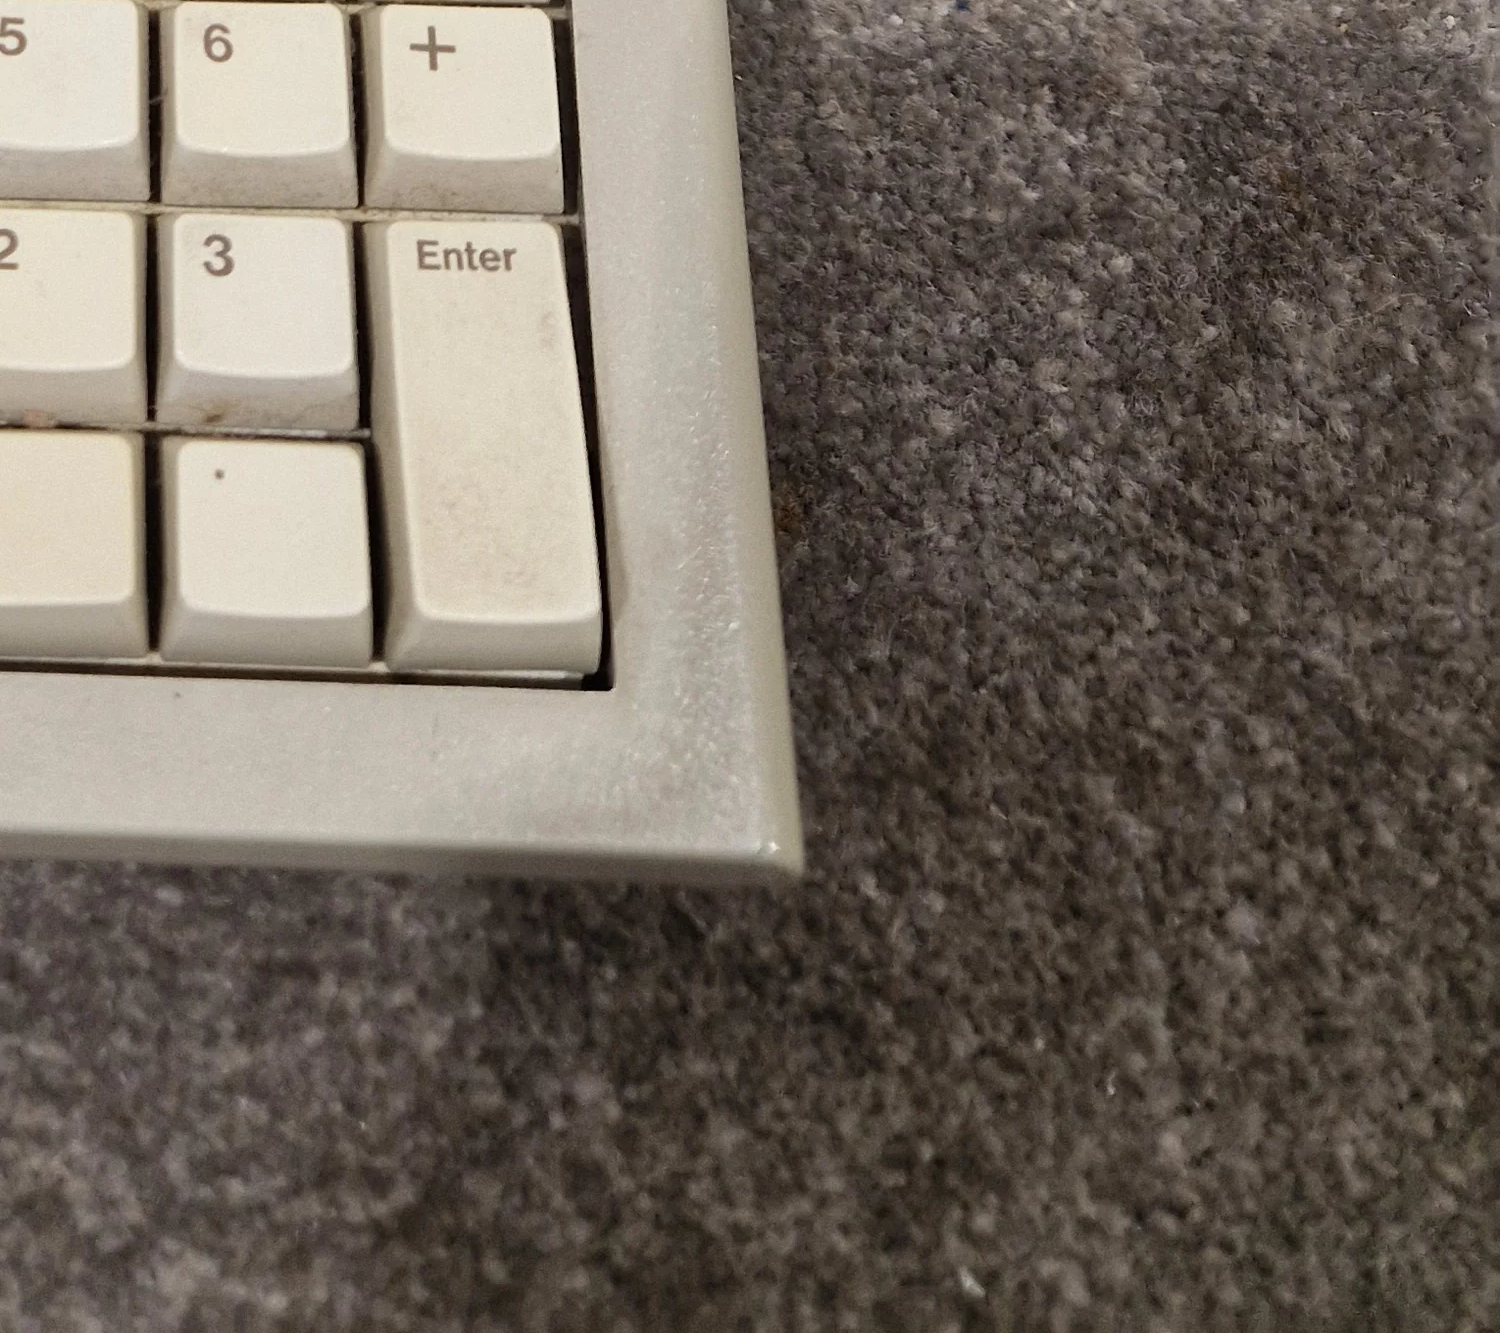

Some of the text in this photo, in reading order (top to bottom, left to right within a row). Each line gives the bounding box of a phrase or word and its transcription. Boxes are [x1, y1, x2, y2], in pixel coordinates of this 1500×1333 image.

[203, 23, 234, 63] 6
[202, 233, 235, 277] 3
[416, 239, 517, 273] Enter
